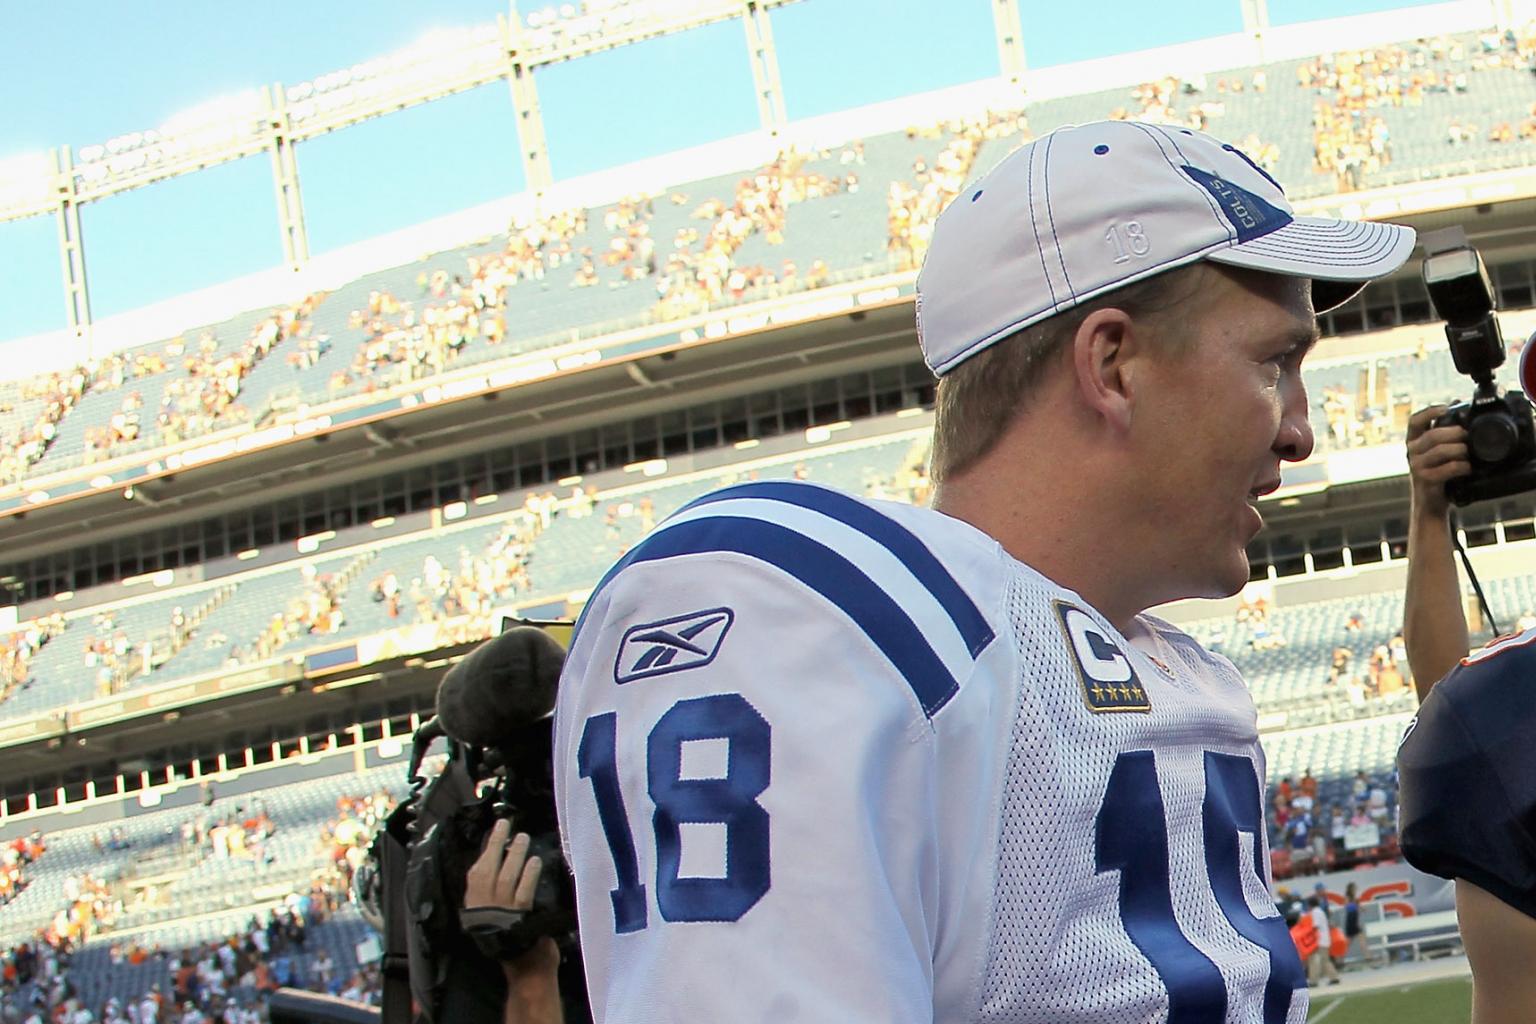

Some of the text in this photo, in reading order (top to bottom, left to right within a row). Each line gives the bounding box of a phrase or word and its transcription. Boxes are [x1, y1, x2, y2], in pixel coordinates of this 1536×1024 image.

[1209, 179, 1256, 228] COLTS
[1105, 220, 1151, 264] 18
[1064, 606, 1134, 683] C
[577, 693, 772, 934] 18
